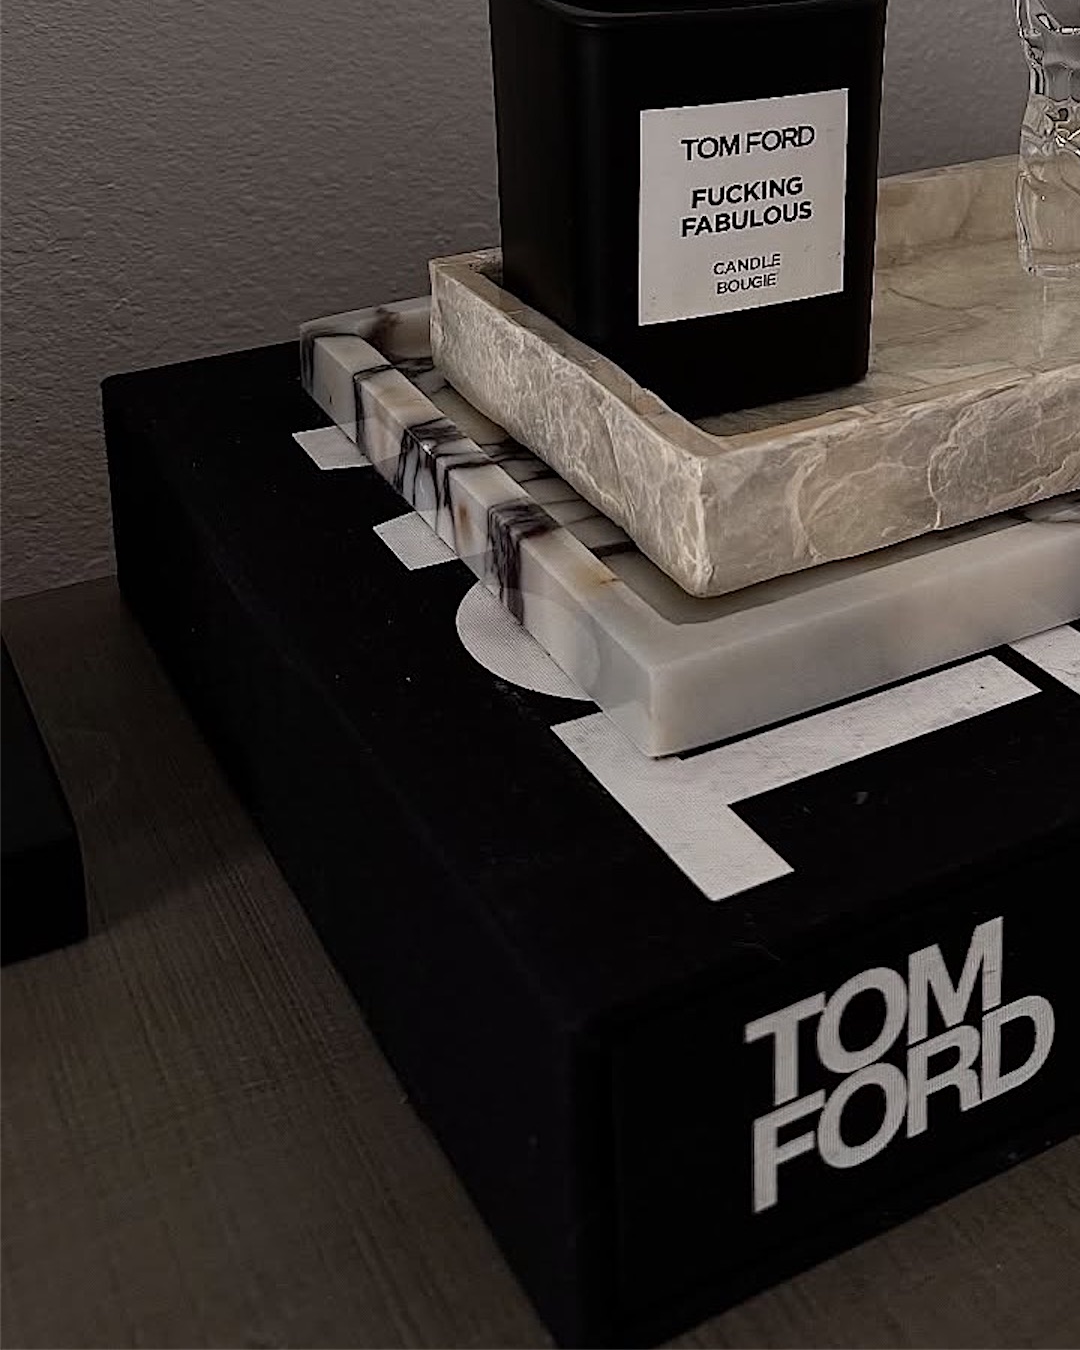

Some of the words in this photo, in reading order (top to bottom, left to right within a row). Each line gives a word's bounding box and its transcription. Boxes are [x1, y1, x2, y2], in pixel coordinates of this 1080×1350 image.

[681, 134, 740, 161] TOM
[746, 125, 815, 154] FORD
[691, 176, 803, 209] FUCKING
[681, 200, 813, 238] FABULOUS
[713, 253, 781, 275] CANDLE
[716, 273, 777, 295] BOUGIE
[745, 916, 1003, 1106] TOM
[752, 994, 1056, 1213] FORD
